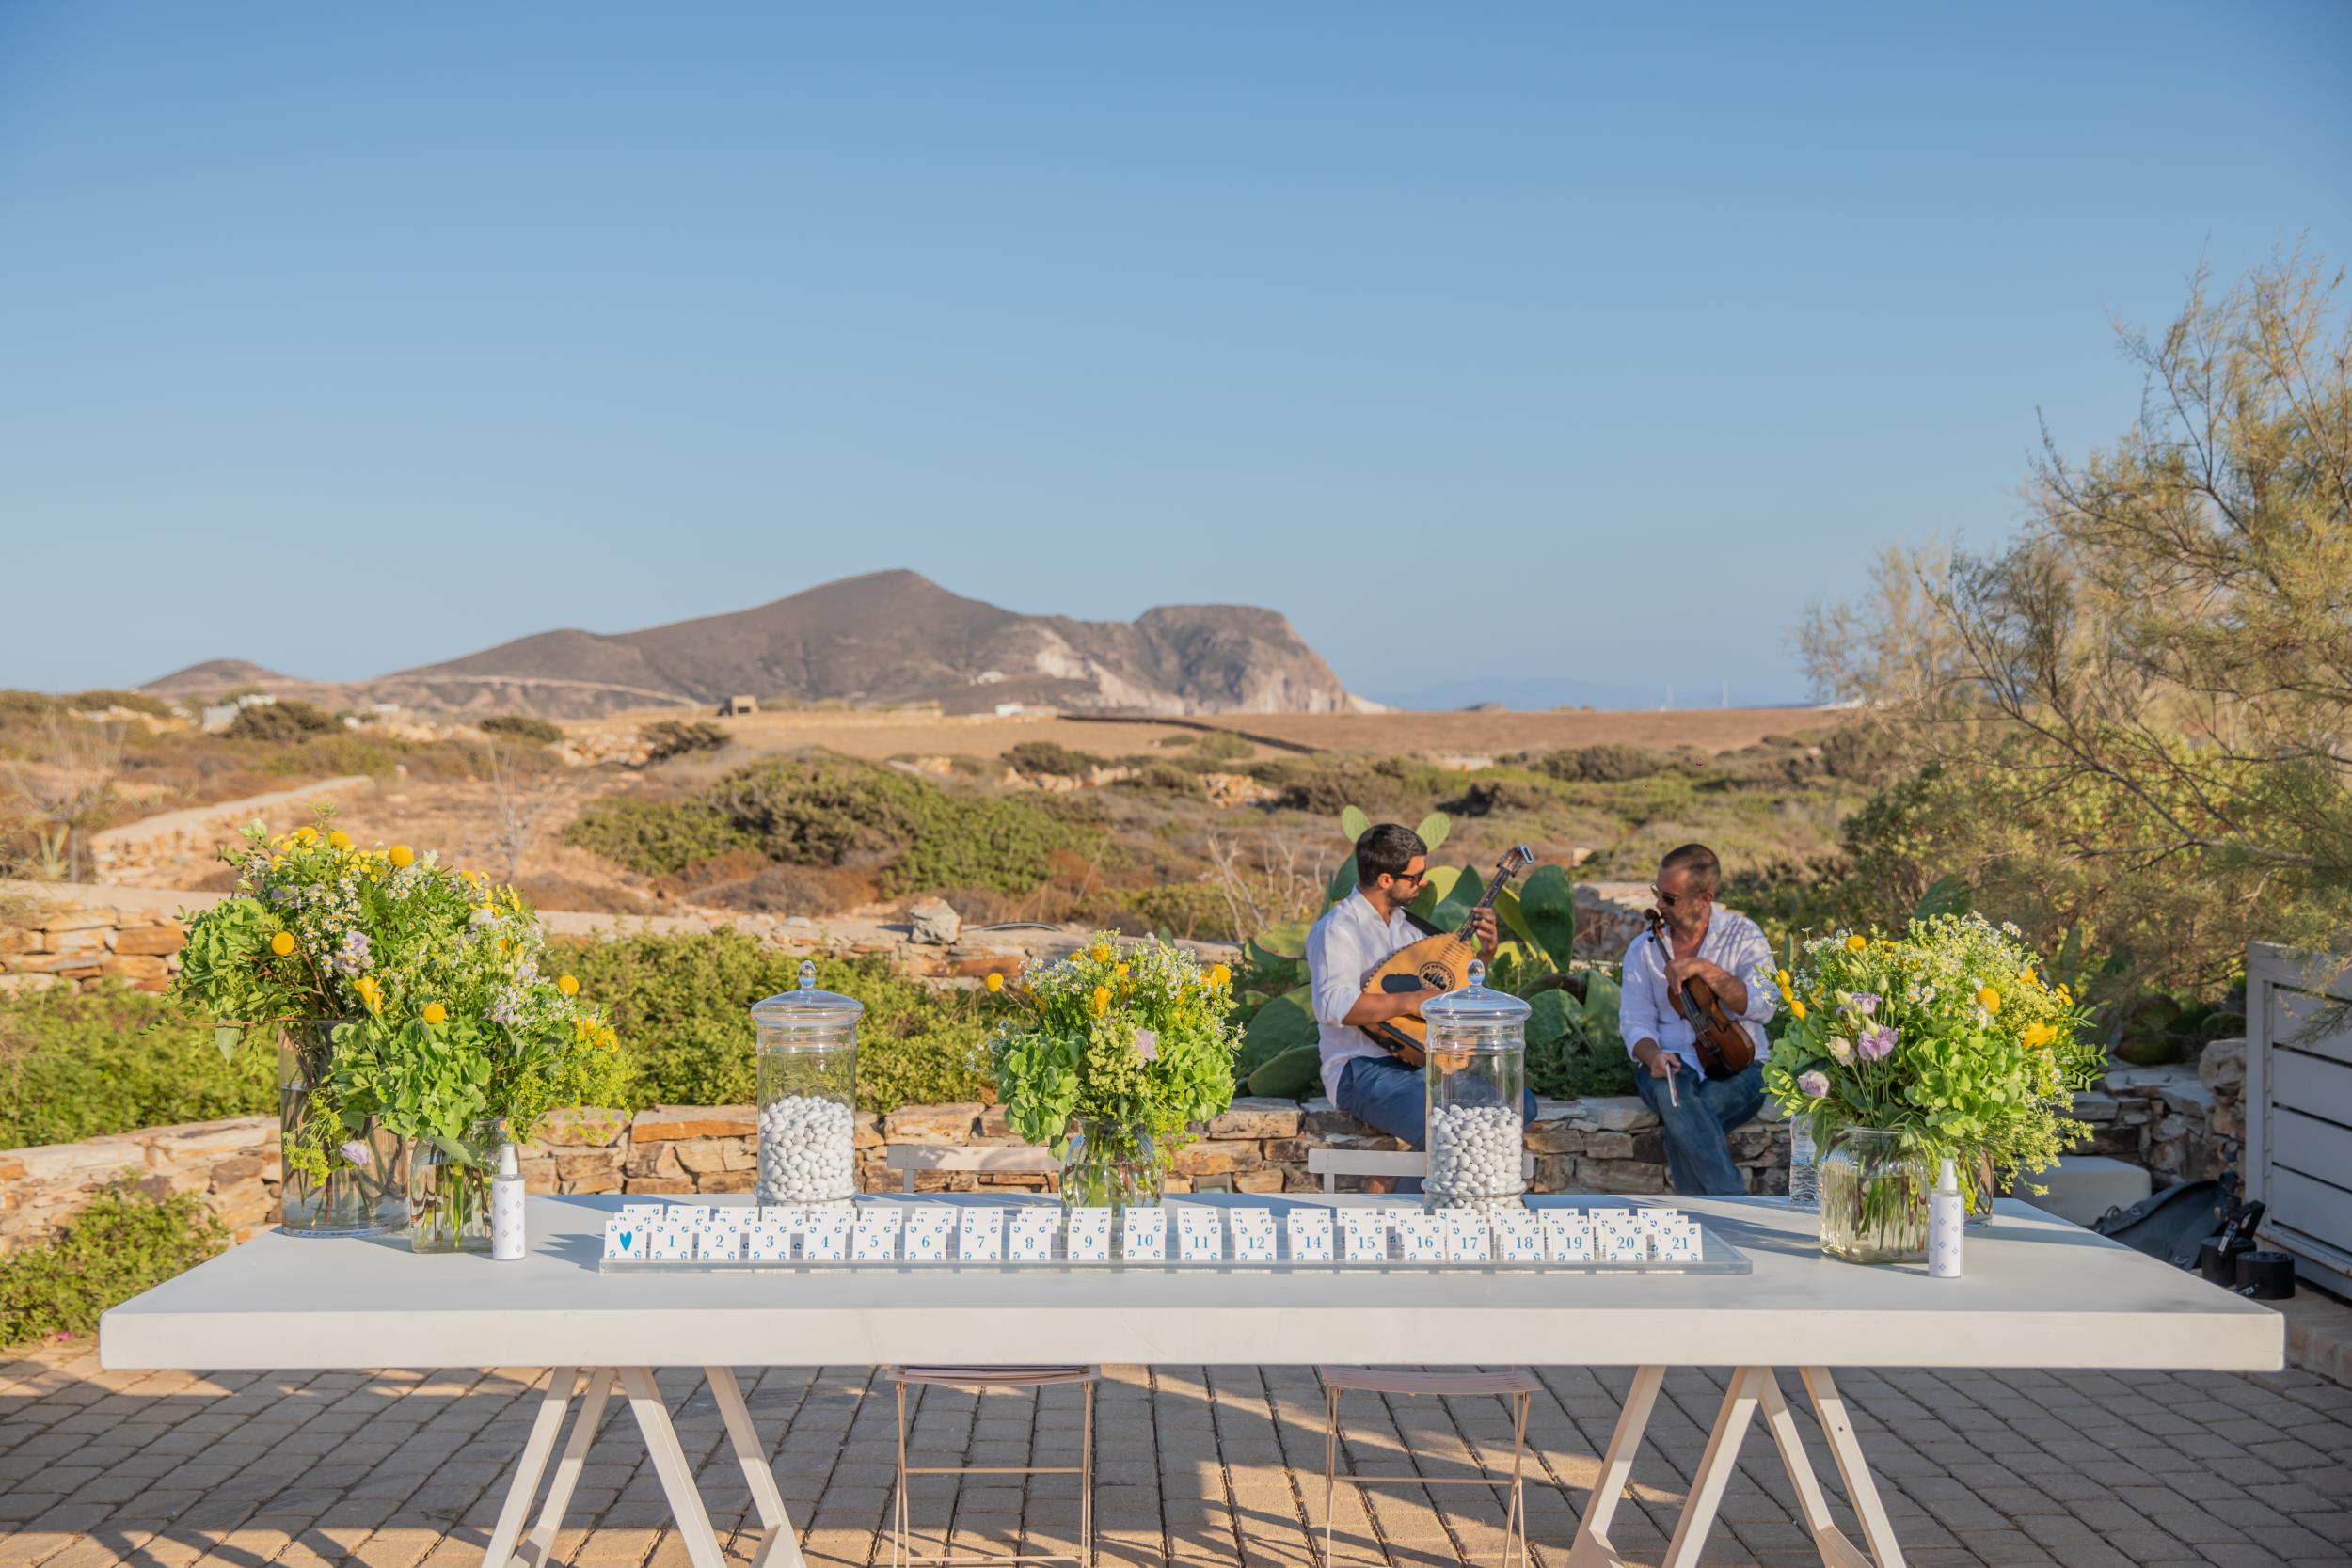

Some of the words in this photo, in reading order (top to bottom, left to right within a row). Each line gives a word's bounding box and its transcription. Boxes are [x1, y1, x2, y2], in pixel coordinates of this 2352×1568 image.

[669, 1234, 675, 1248] 1
[715, 1234, 723, 1248] 2
[765, 1235, 774, 1248] 3
[820, 1235, 829, 1248] 4
[870, 1235, 879, 1248] 5
[921, 1235, 930, 1248] 6
[977, 1235, 985, 1248] 7
[1025, 1236, 1034, 1249] 8
[1085, 1235, 1093, 1248] 9
[1136, 1233, 1153, 1247] 10
[1194, 1236, 1209, 1249] 11
[1248, 1236, 1265, 1249] 12
[1305, 1236, 1322, 1249] 14
[1359, 1236, 1375, 1249] 15
[1417, 1235, 1434, 1249] 16
[1461, 1236, 1478, 1250] 17
[1516, 1236, 1534, 1249] 18
[1565, 1236, 1582, 1249] 19
[1616, 1236, 1635, 1249] 20
[1672, 1236, 1688, 1249] 21
